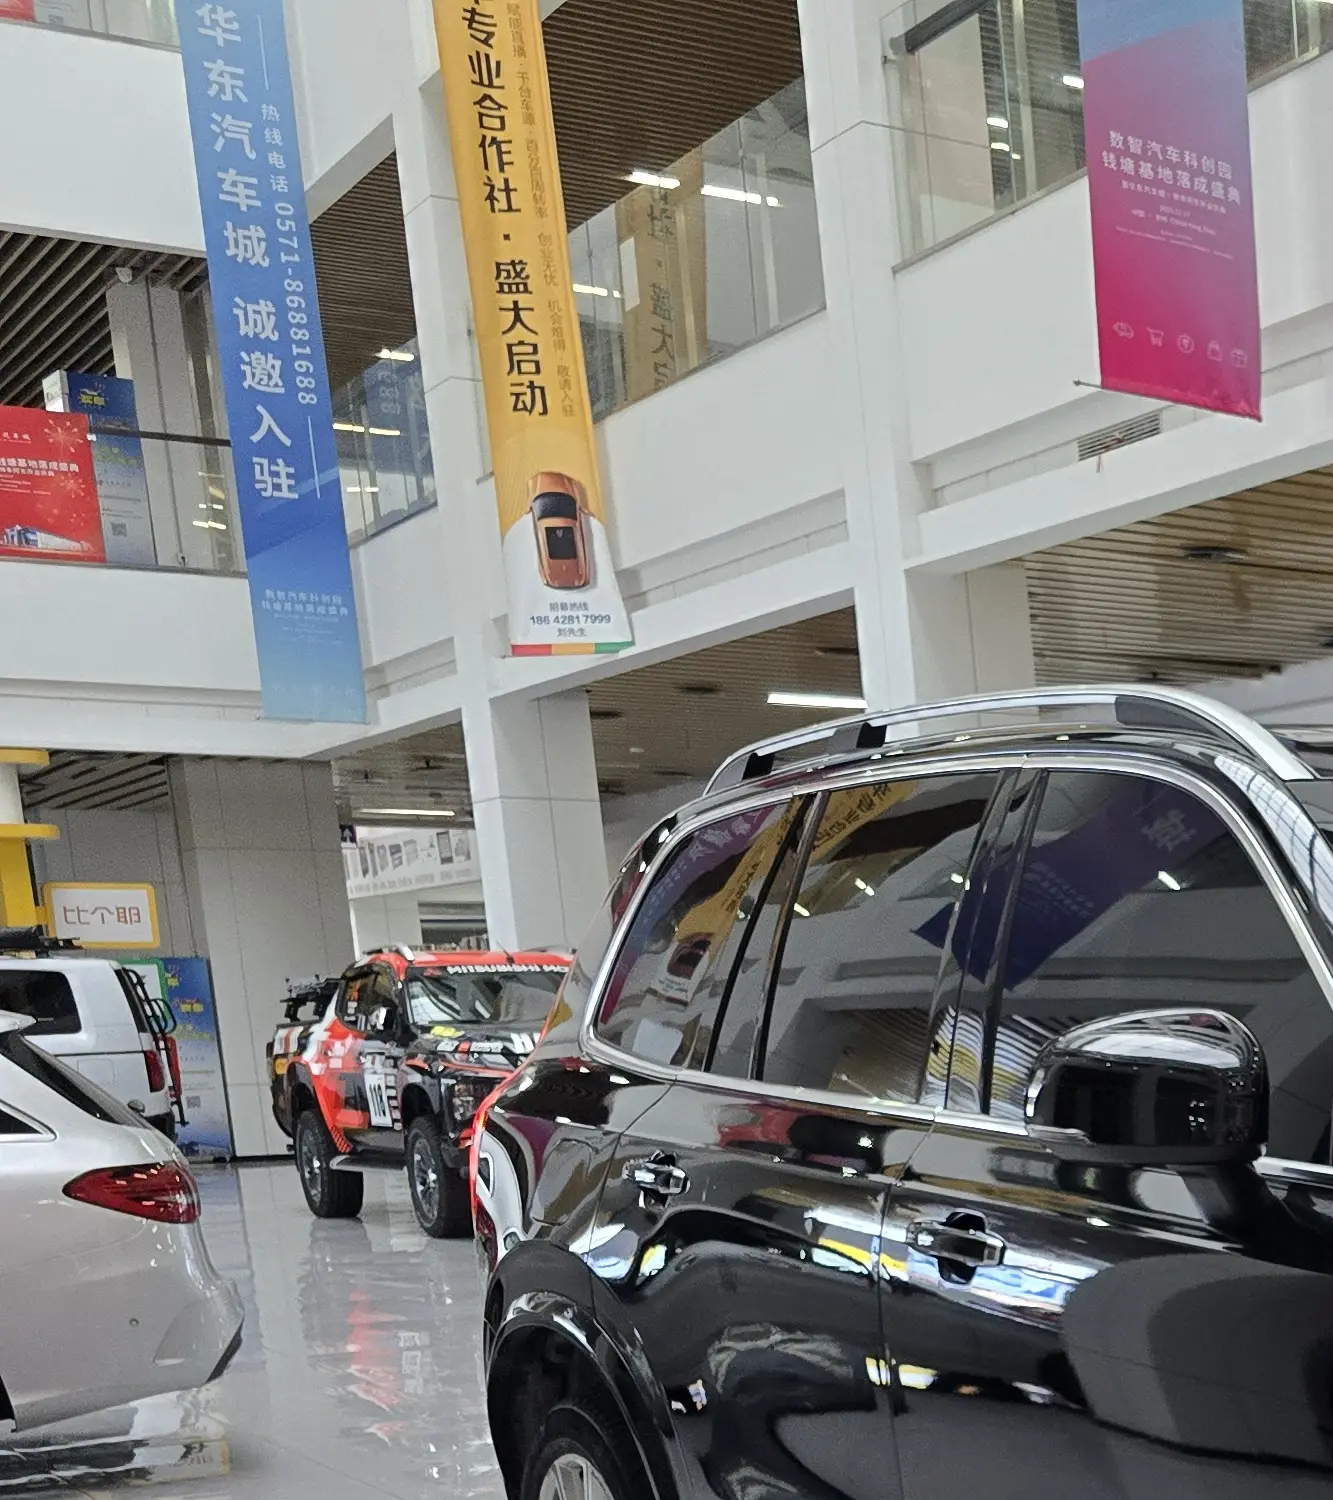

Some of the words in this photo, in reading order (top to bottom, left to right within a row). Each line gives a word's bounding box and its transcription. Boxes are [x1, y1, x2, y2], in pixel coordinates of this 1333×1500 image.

[195, 3, 270, 267] 华东汽车城
[260, 103, 289, 193] 热线电话
[462, 0, 548, 416] 专业合作社·盛大启动
[232, 297, 299, 499] 诚邀入驻
[274, 202, 318, 405] 0571-86881688
